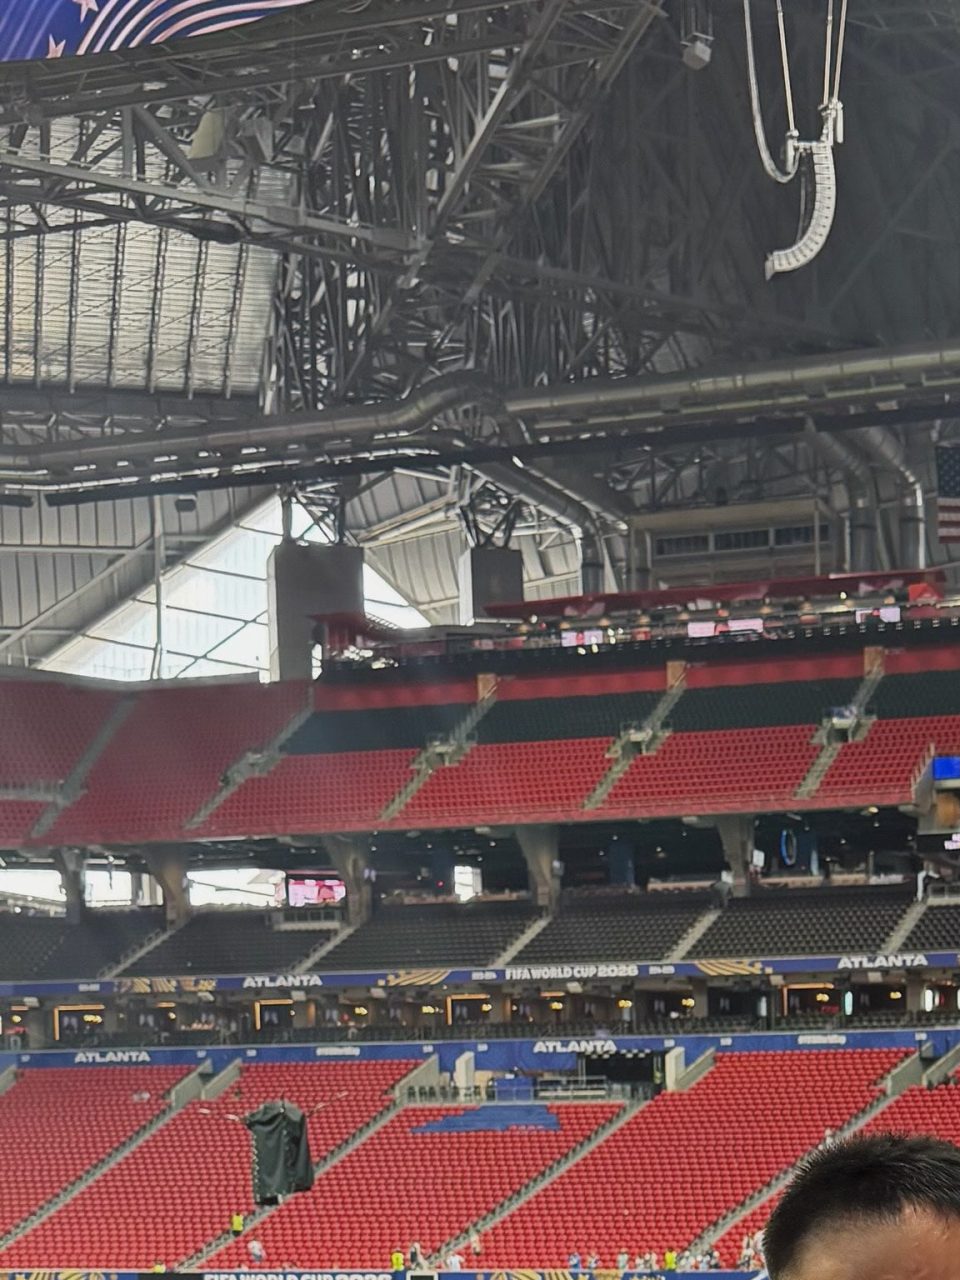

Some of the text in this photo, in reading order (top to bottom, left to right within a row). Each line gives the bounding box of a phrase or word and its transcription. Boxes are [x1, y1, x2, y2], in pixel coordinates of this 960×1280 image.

[838, 954, 928, 969] ATLANTA
[505, 967, 531, 980] FIFA
[531, 965, 573, 979] WORLD
[573, 965, 598, 978] CUP
[597, 964, 639, 977] 2026
[243, 974, 324, 988] ATLANTA
[533, 1041, 617, 1053] ATLANTA
[75, 1051, 151, 1063] ATLANTA
